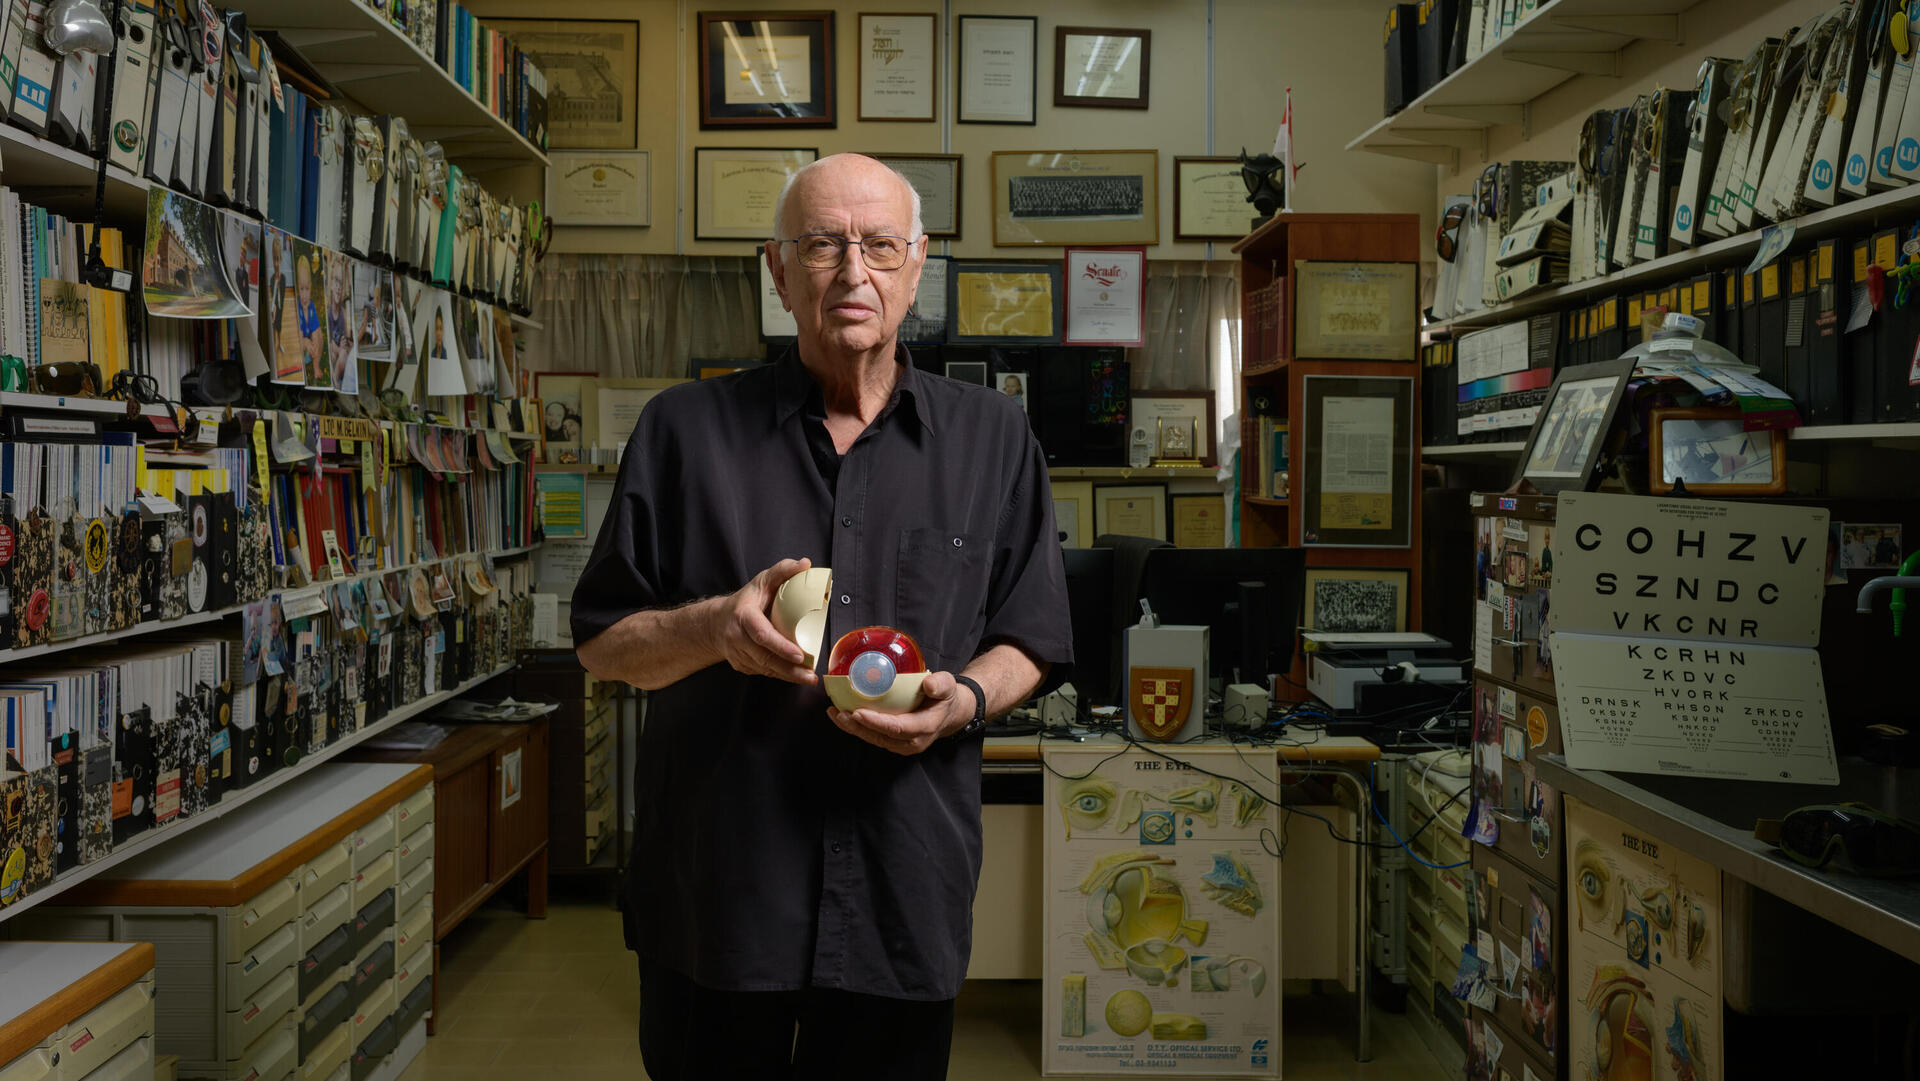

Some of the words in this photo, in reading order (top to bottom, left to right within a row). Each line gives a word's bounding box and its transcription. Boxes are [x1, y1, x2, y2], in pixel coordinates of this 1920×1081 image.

[1083, 262, 1122, 284] Senate
[1135, 761, 1161, 770] THE
[1622, 833, 1640, 851] THE
[1641, 840, 1658, 858] EYE
